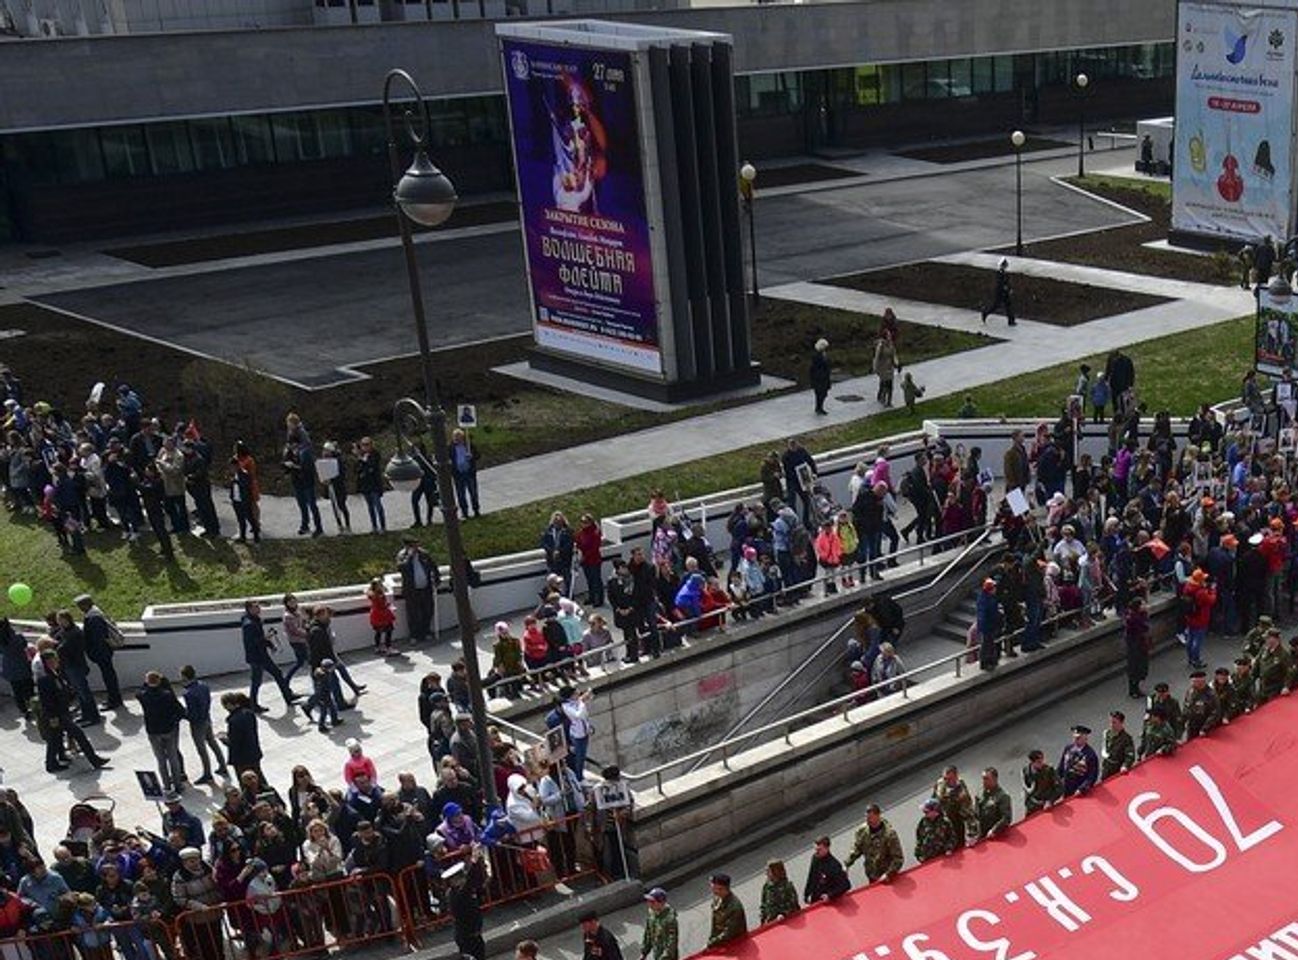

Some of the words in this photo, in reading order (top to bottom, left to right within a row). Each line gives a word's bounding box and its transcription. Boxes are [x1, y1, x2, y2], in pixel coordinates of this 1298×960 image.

[541, 235, 635, 273] ВОЛШЕБНАЯ
[558, 263, 623, 294] ФЛЕЙТА
[1127, 765, 1284, 873] 79
